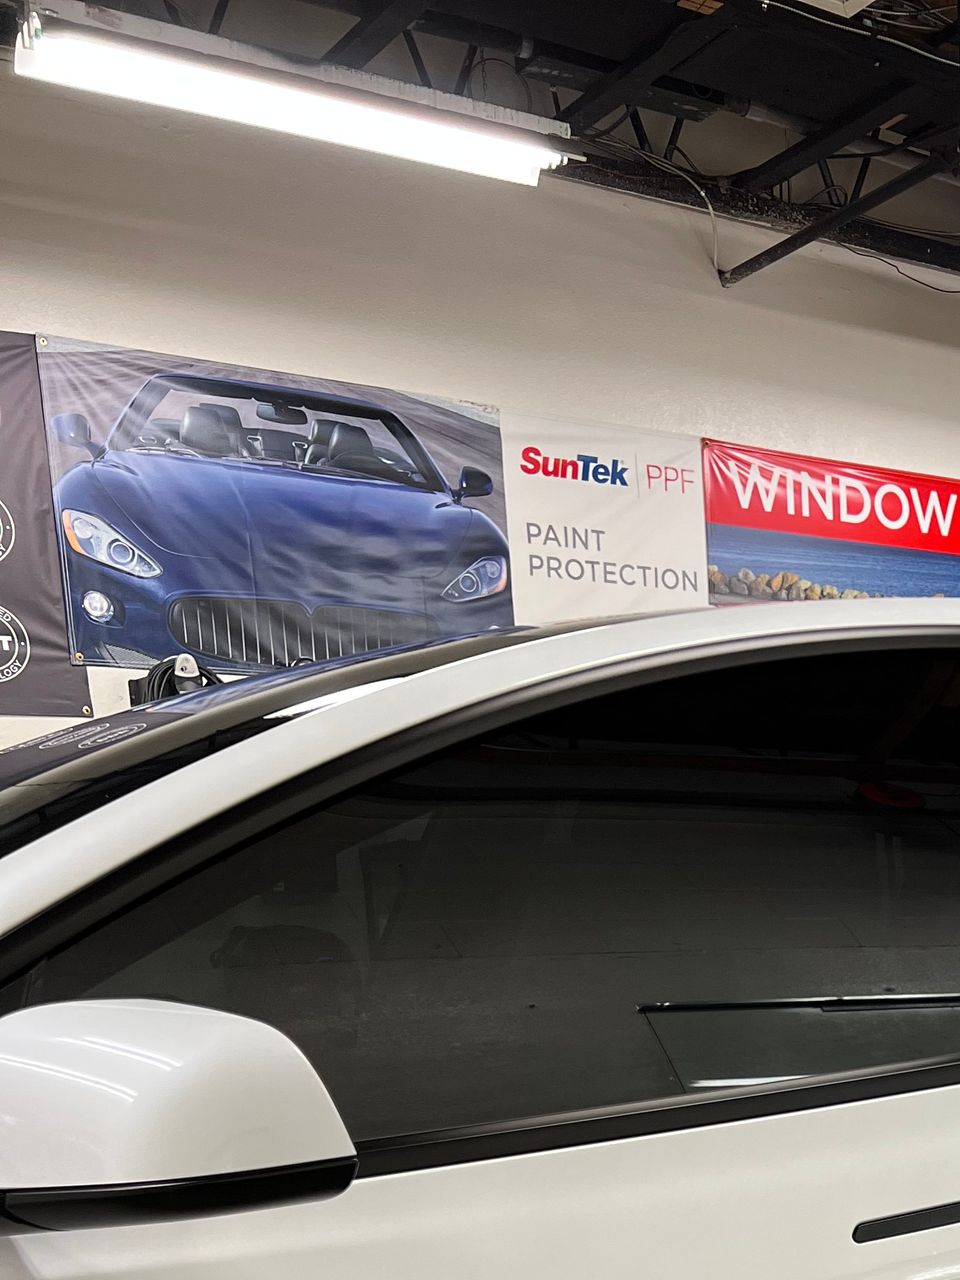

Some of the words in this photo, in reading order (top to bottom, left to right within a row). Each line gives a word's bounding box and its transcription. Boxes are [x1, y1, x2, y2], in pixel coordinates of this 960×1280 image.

[520, 447, 629, 487] SunTek
[646, 464, 695, 494] PPF
[728, 461, 958, 537] WINDOW
[526, 522, 606, 551] PAINT
[529, 554, 698, 592] PROTECTION
